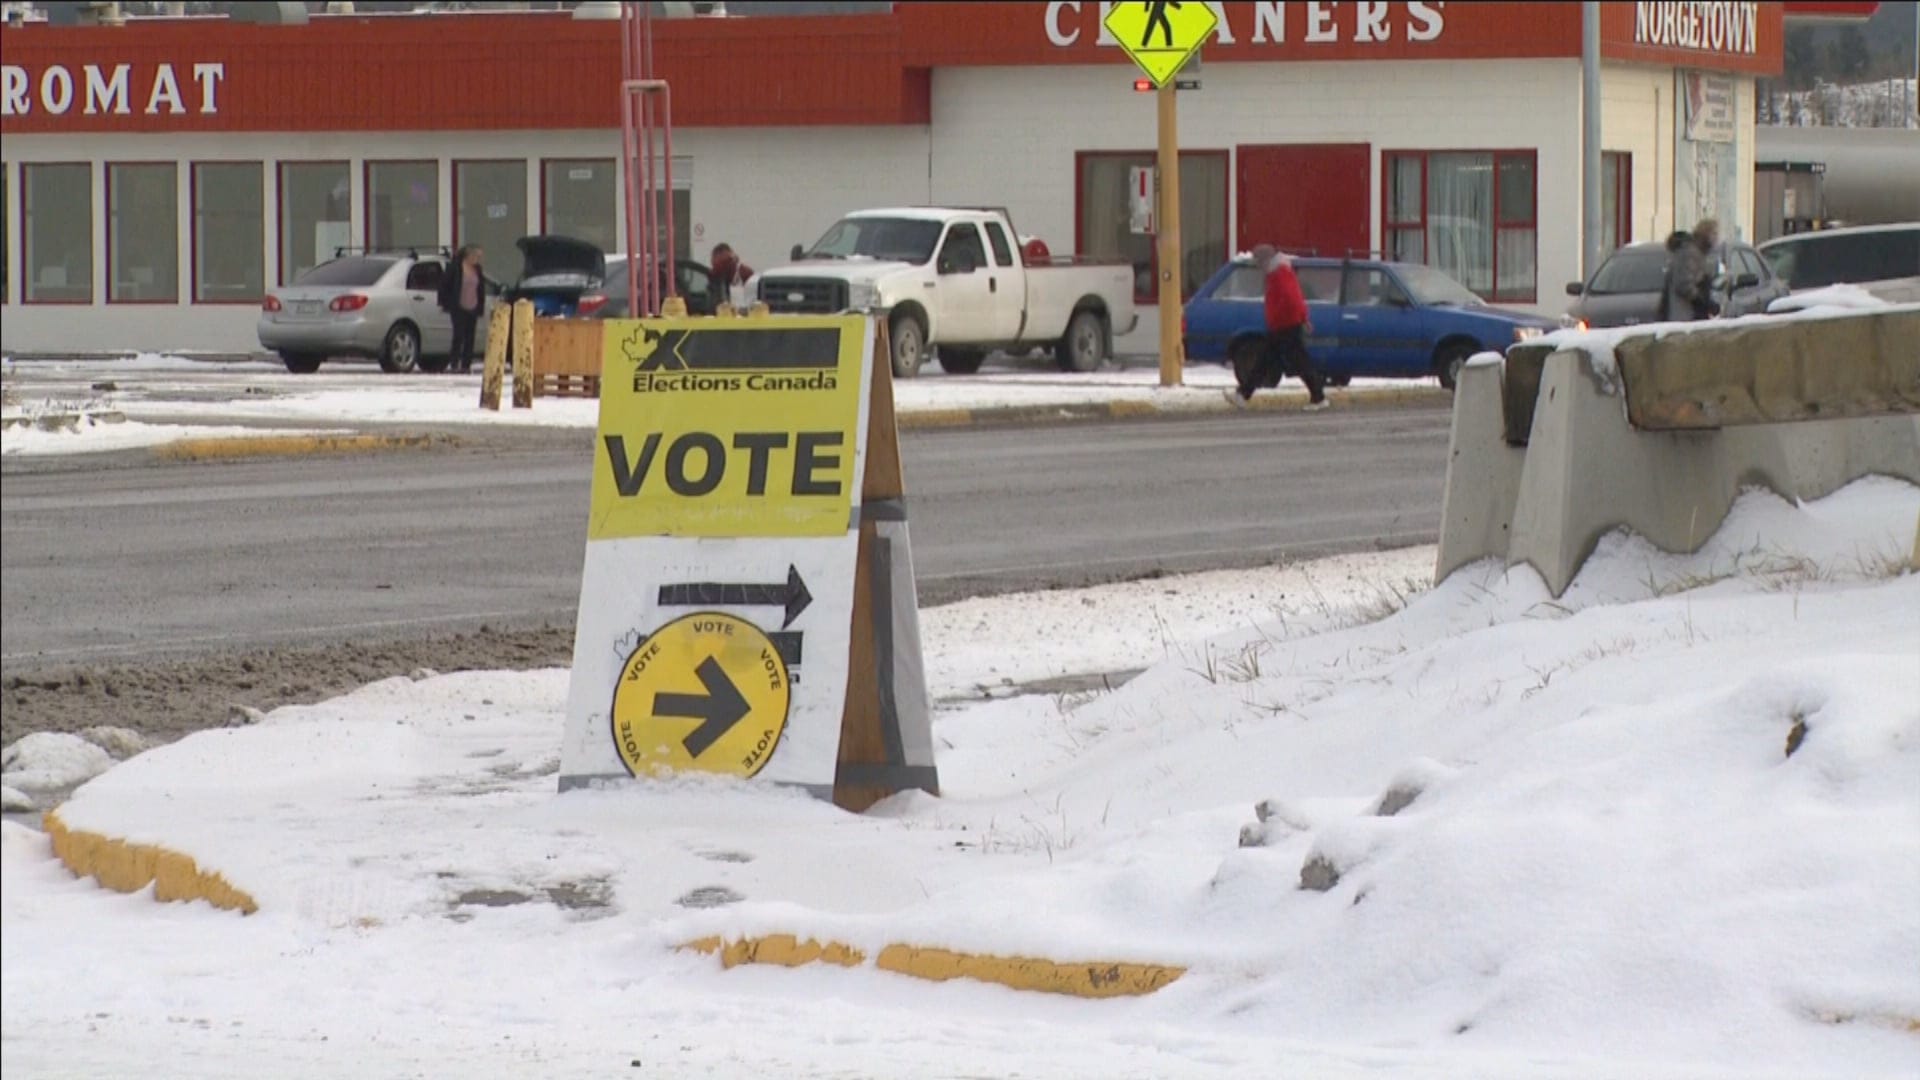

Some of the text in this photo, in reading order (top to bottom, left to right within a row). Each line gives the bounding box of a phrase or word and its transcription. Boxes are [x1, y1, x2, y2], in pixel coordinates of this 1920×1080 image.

[1044, 1, 1444, 46] CLANERS
[1635, 1, 1757, 54] NORGETOWN
[1, 63, 224, 115] ROMAT
[633, 370, 838, 393] Elections Canada
[603, 431, 844, 497] VOTE
[693, 621, 734, 636] VOTE
[627, 642, 661, 683] VOTE
[760, 648, 782, 691] VOTE
[620, 720, 641, 764] VOTE
[742, 729, 774, 769] VOTE
